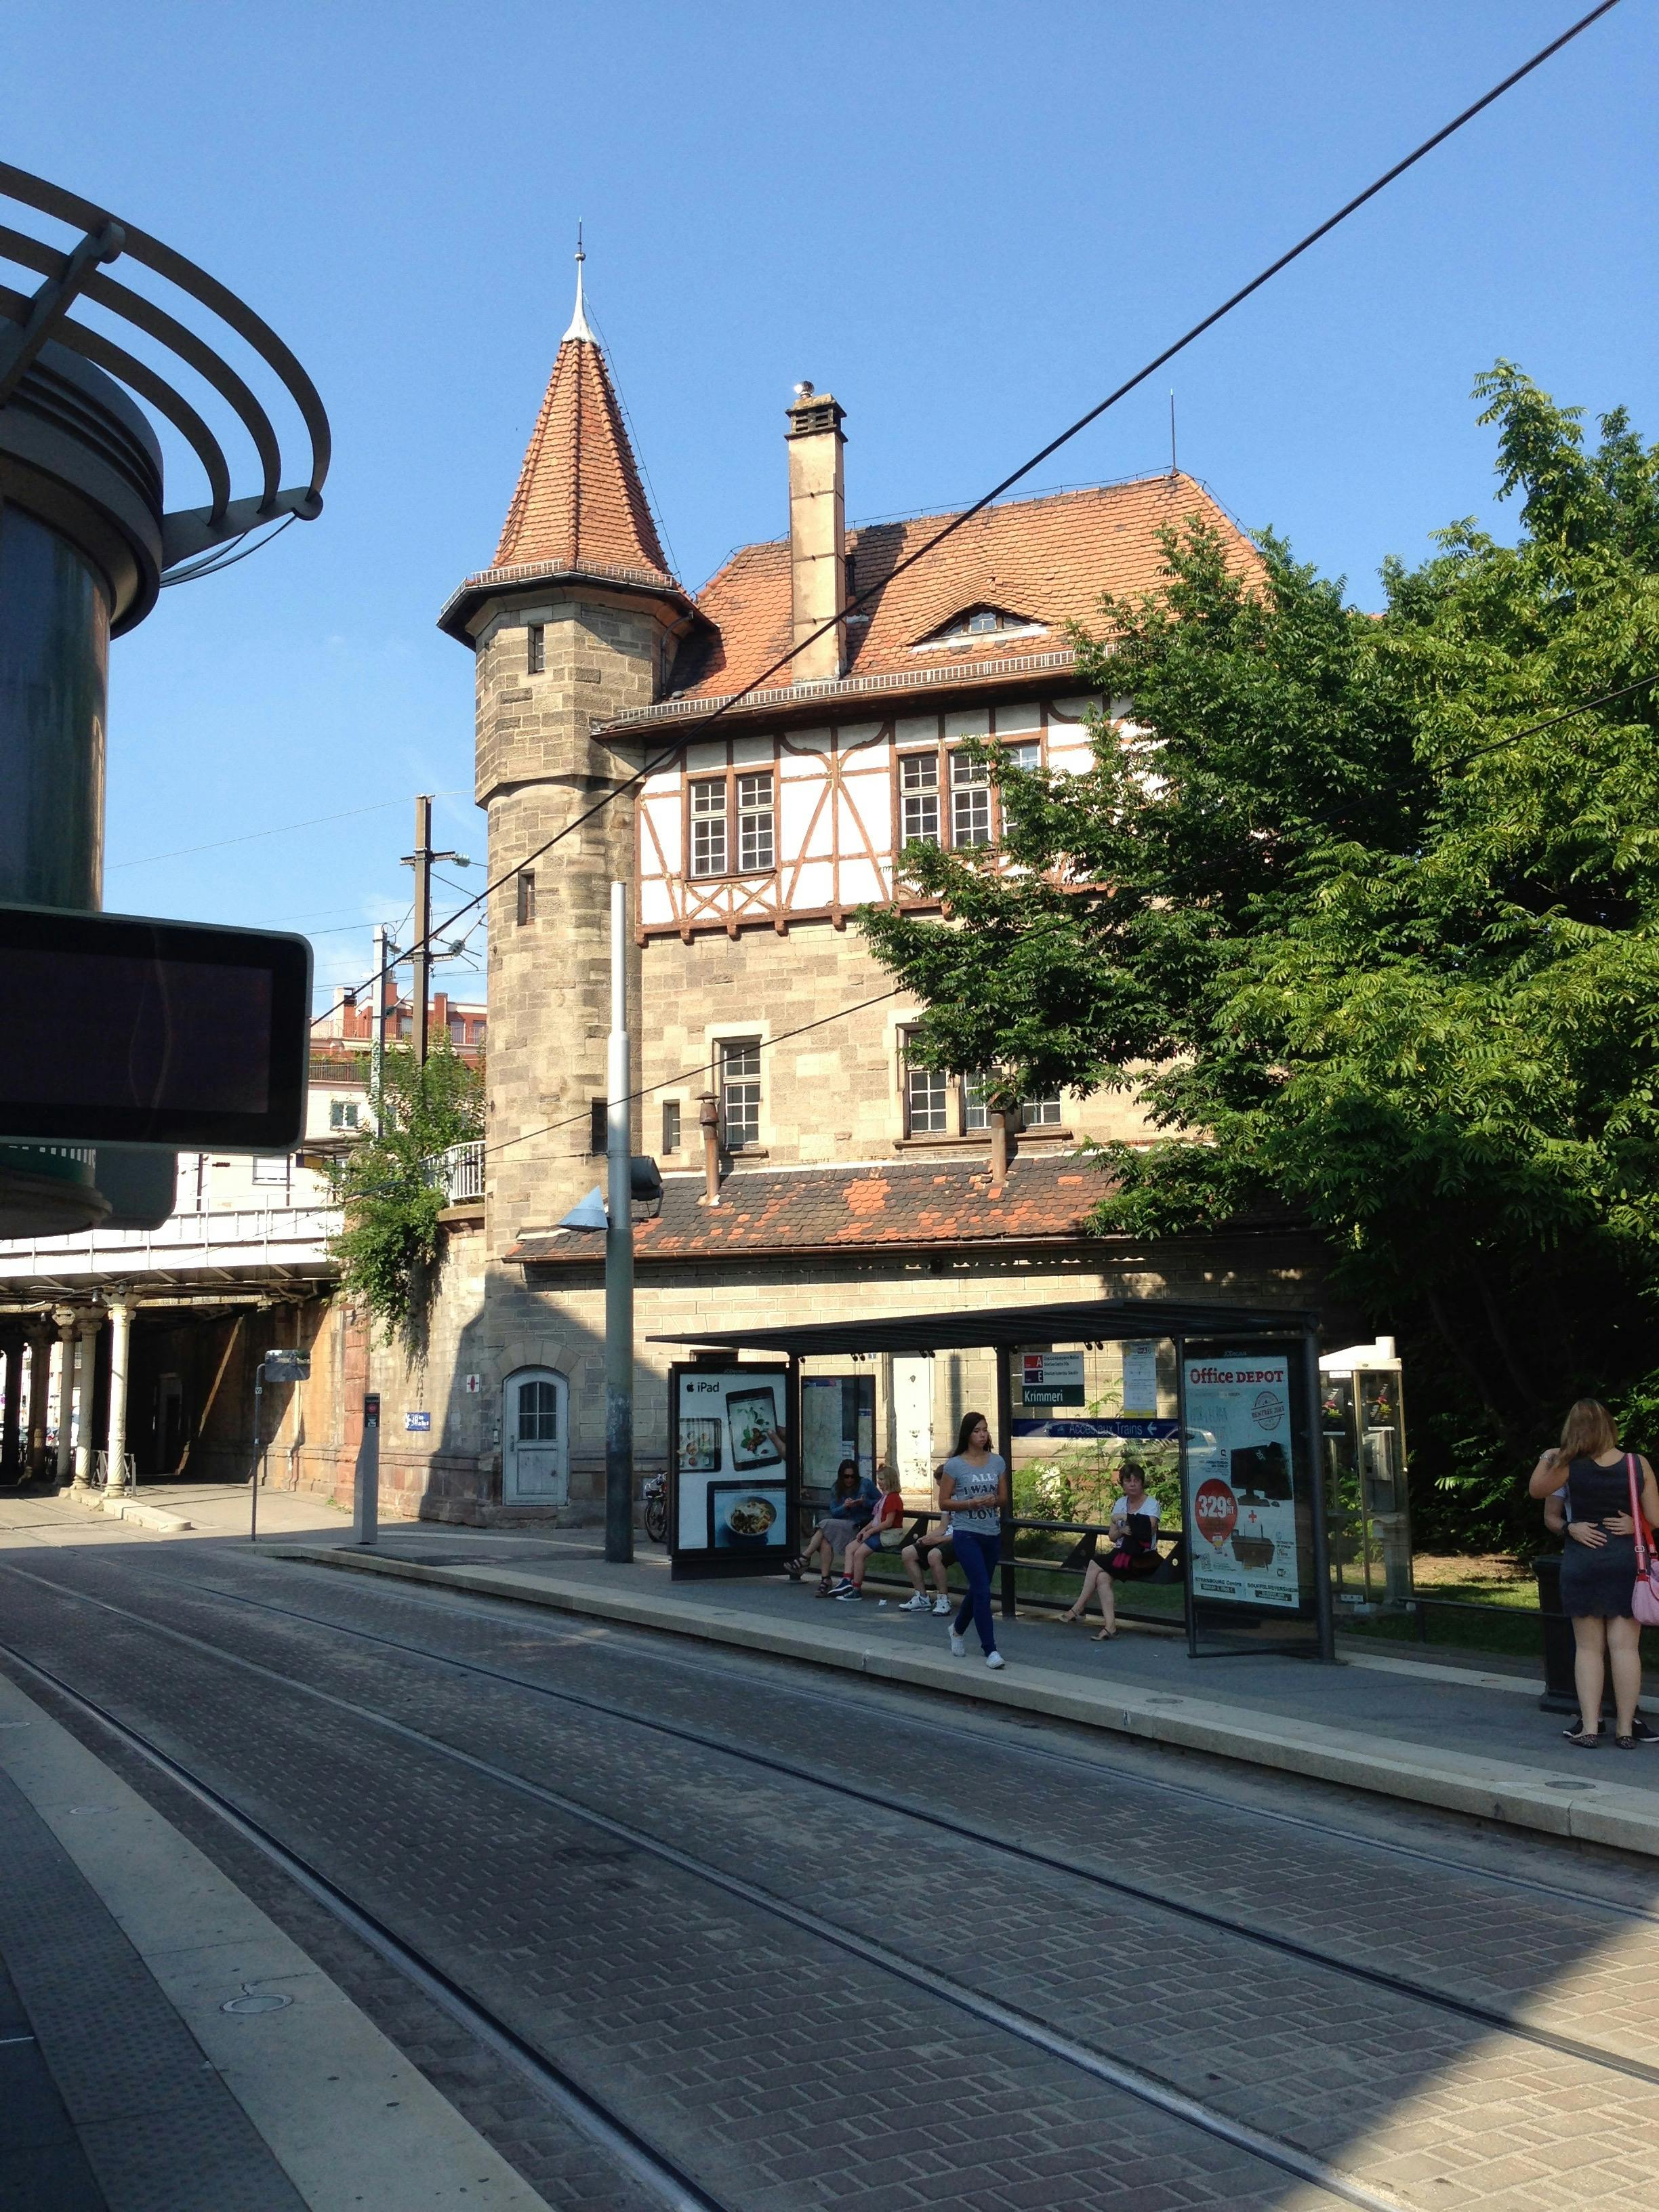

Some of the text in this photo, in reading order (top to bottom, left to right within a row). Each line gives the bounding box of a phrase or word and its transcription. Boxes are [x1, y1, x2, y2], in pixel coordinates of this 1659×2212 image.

[1036, 1356, 1042, 1367] A
[1038, 1371, 1043, 1382] E
[1190, 1368, 1284, 1384] Office DEPOT
[697, 1382, 720, 1393] iPad
[1025, 1389, 1063, 1402] Krimmeri
[1098, 1425, 1113, 1434] aux
[1115, 1422, 1143, 1435] Trains
[972, 1473, 995, 1482] ALL
[964, 1486, 968, 1495] I
[1198, 1495, 1227, 1518] 329
